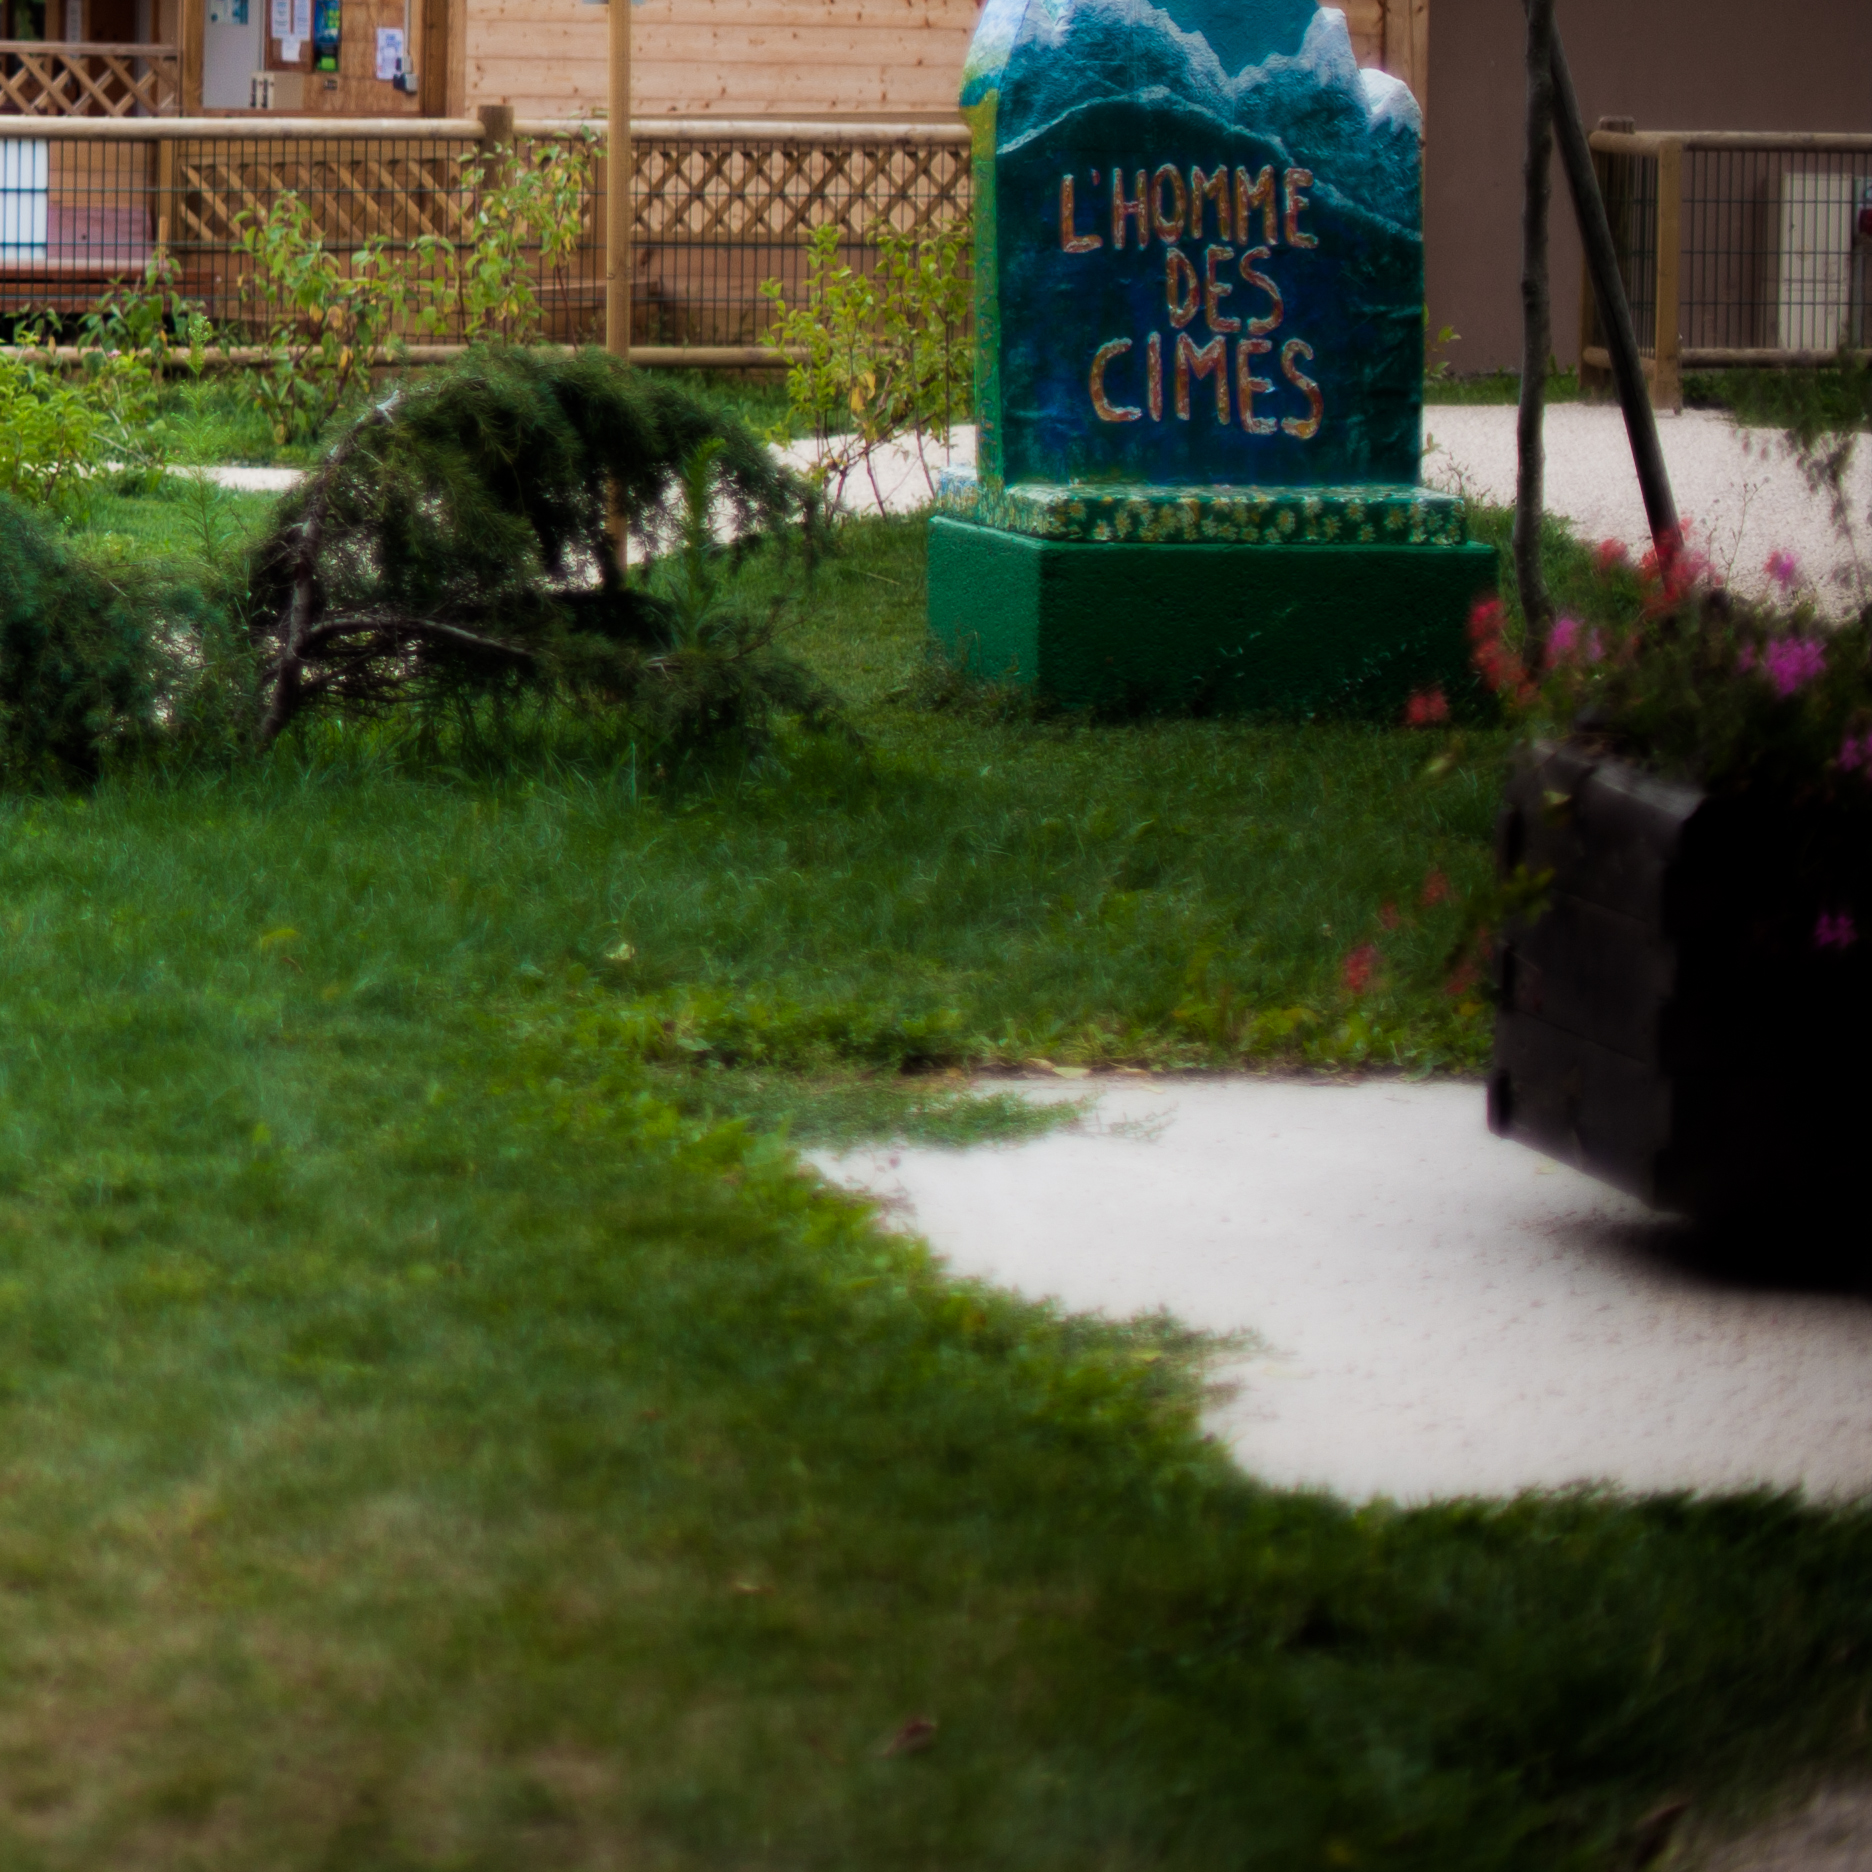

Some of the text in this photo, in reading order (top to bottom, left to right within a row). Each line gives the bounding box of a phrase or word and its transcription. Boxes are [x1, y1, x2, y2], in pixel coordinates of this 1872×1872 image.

[1061, 163, 1319, 252] L'HOMME
[1166, 244, 1284, 334] DES
[1090, 331, 1324, 439] CIMES
